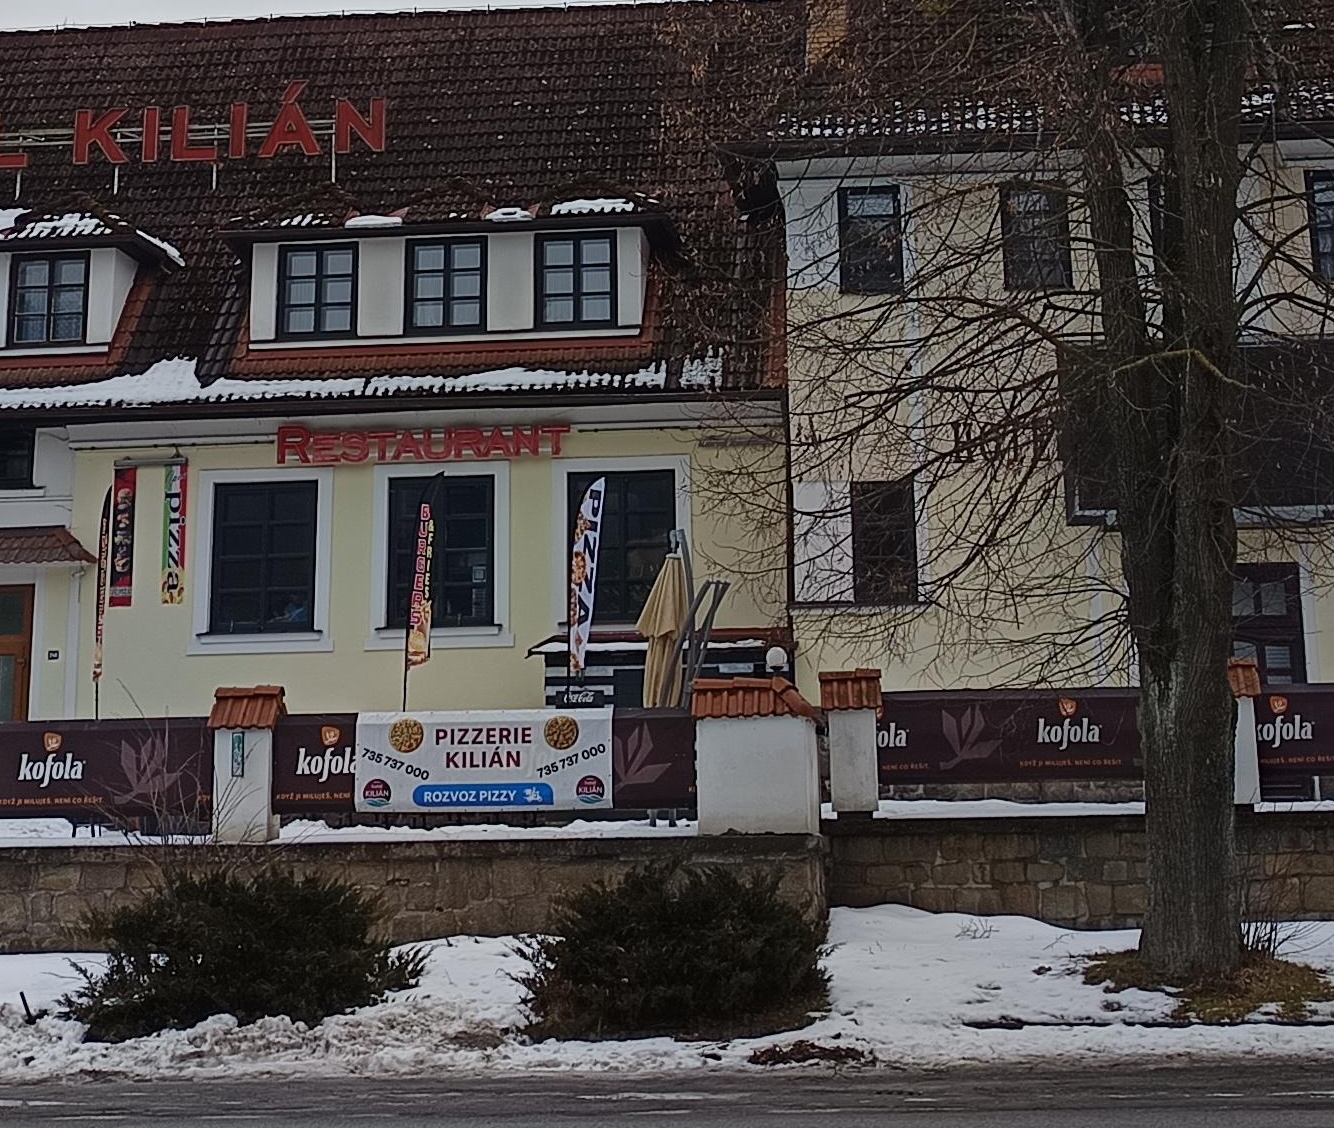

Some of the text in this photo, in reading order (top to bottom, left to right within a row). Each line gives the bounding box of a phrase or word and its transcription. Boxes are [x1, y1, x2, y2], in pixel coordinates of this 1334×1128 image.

[73, 79, 386, 165] KILIÁN
[164, 491, 186, 594] pizza
[577, 489, 602, 627] PIZZA
[410, 503, 431, 626] BURGERS
[435, 727, 533, 746] PIZZERIE
[877, 722, 907, 748] ola
[1037, 717, 1100, 750] kofola
[18, 752, 83, 788] kofola
[362, 747, 429, 780] 735 737 000
[445, 746, 521, 769] KILIÁN
[536, 743, 605, 778] 735 737 000
[424, 789, 517, 803] ROZVOZ PIZZY
